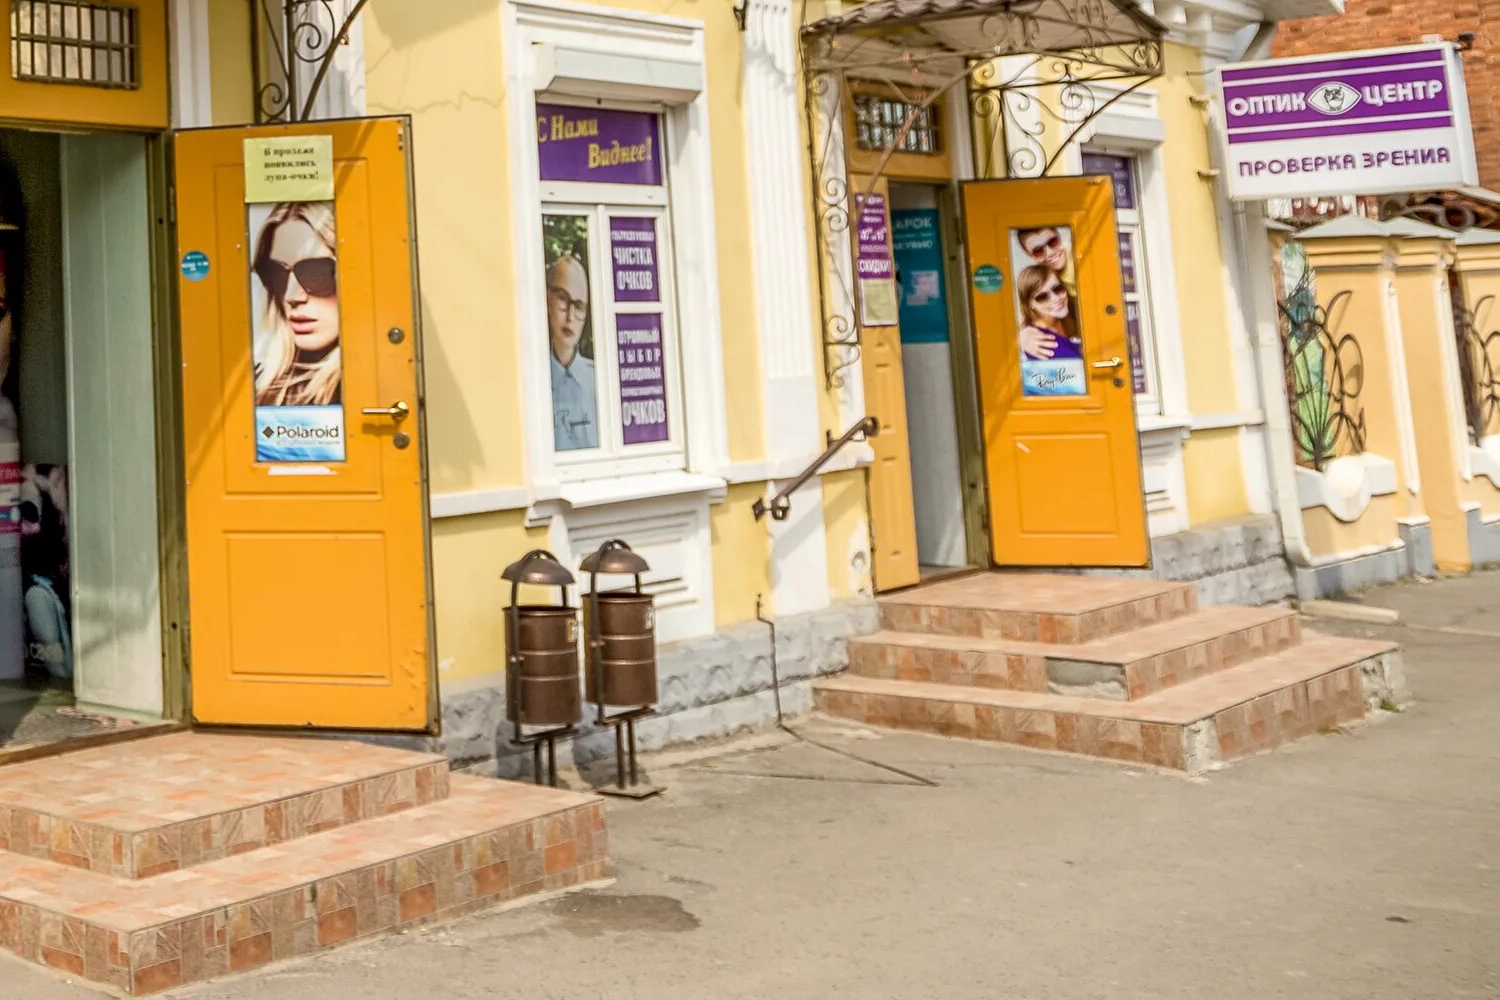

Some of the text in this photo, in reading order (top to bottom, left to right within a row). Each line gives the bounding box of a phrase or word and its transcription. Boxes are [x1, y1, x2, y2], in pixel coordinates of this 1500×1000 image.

[1228, 80, 1442, 116] ОПТИК ЦЕНТР
[550, 115, 598, 141] Нами
[1239, 147, 1450, 177] ПРОВЕРКА ЗРЕНИЯ
[613, 247, 653, 265] ЧИСТКА
[616, 270, 653, 290] ОЧКОВ
[623, 400, 666, 426] ОЧКОВ
[277, 425, 339, 438] Polaroid
